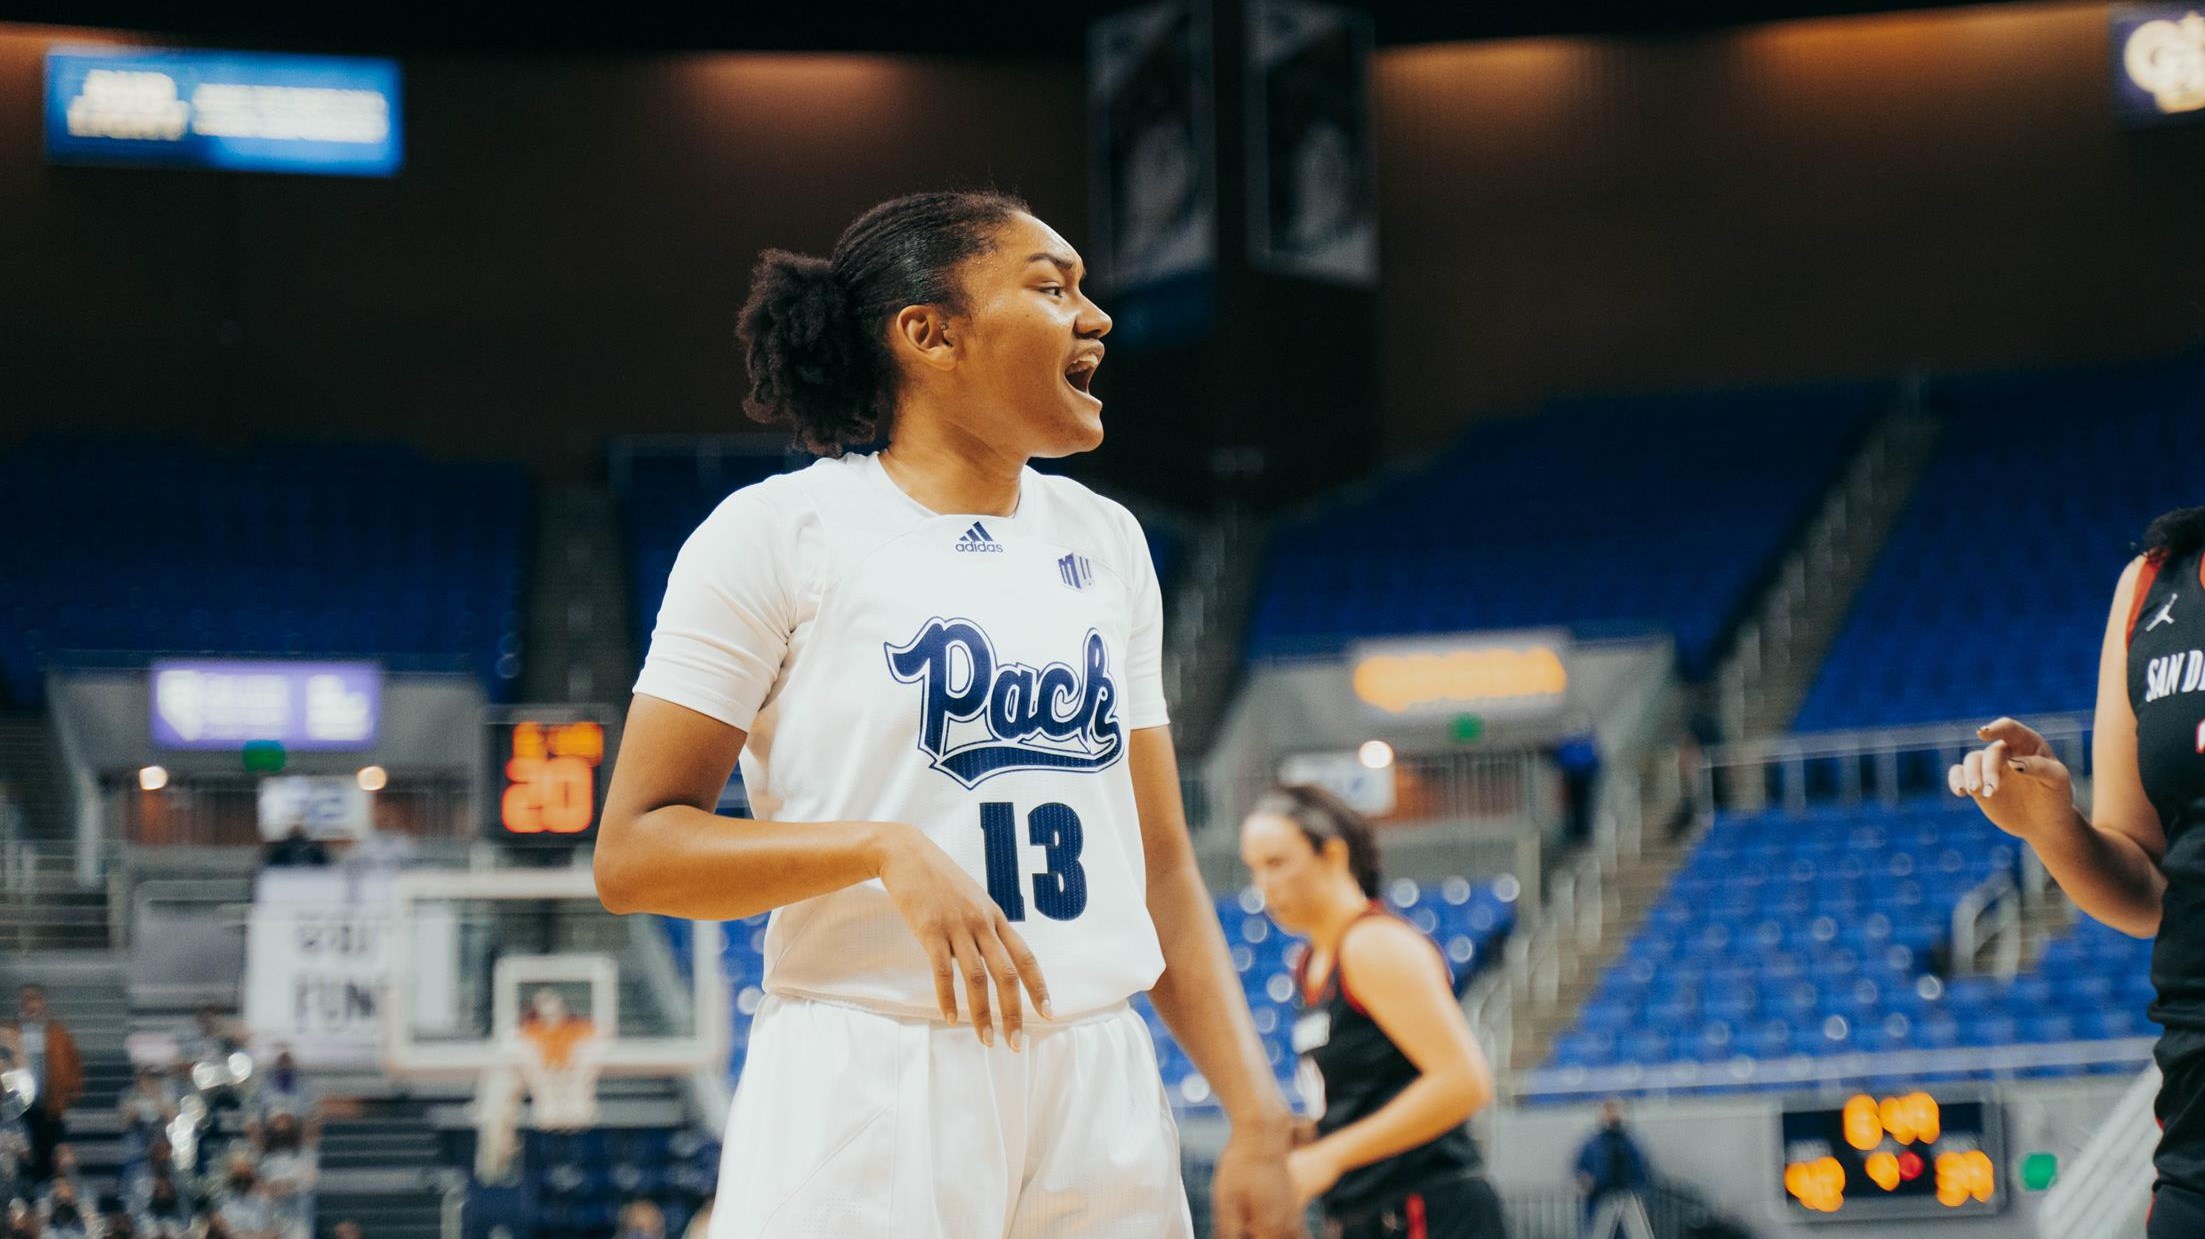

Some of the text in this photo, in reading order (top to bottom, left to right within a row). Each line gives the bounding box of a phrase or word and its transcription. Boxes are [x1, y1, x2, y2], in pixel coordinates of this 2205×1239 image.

[955, 540, 1004, 553] adidas
[884, 615, 1125, 790] Pack
[2145, 652, 2186, 702] SAN
[979, 801, 1089, 922] 13
